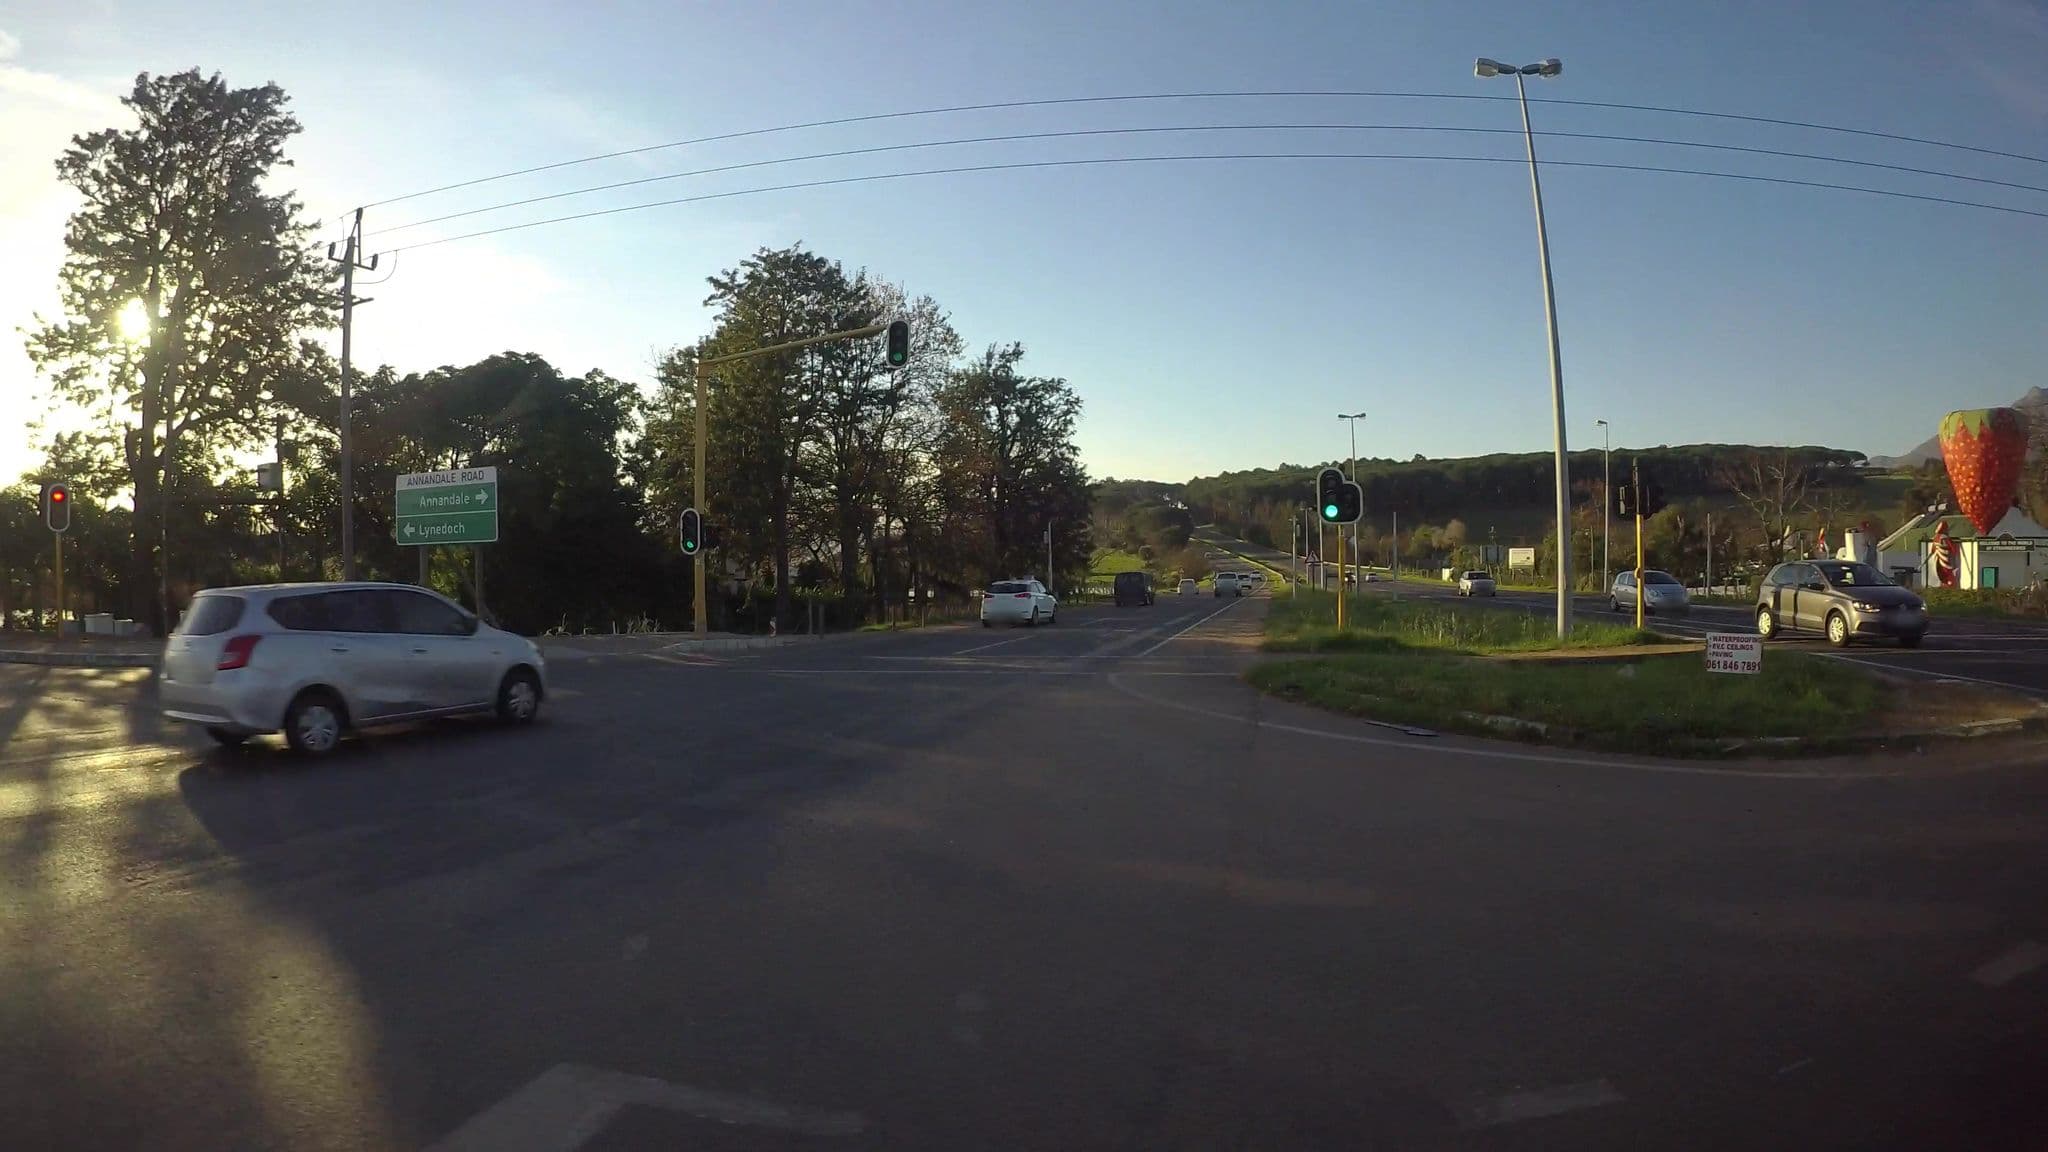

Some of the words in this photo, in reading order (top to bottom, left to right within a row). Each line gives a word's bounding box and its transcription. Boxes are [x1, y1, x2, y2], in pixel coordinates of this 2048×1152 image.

[407, 473, 456, 486] ANNANDALE
[462, 470, 484, 482] ROAD
[420, 493, 470, 507] Annandale
[419, 522, 465, 538] Lynedoch
[1722, 661, 1739, 670] 846
